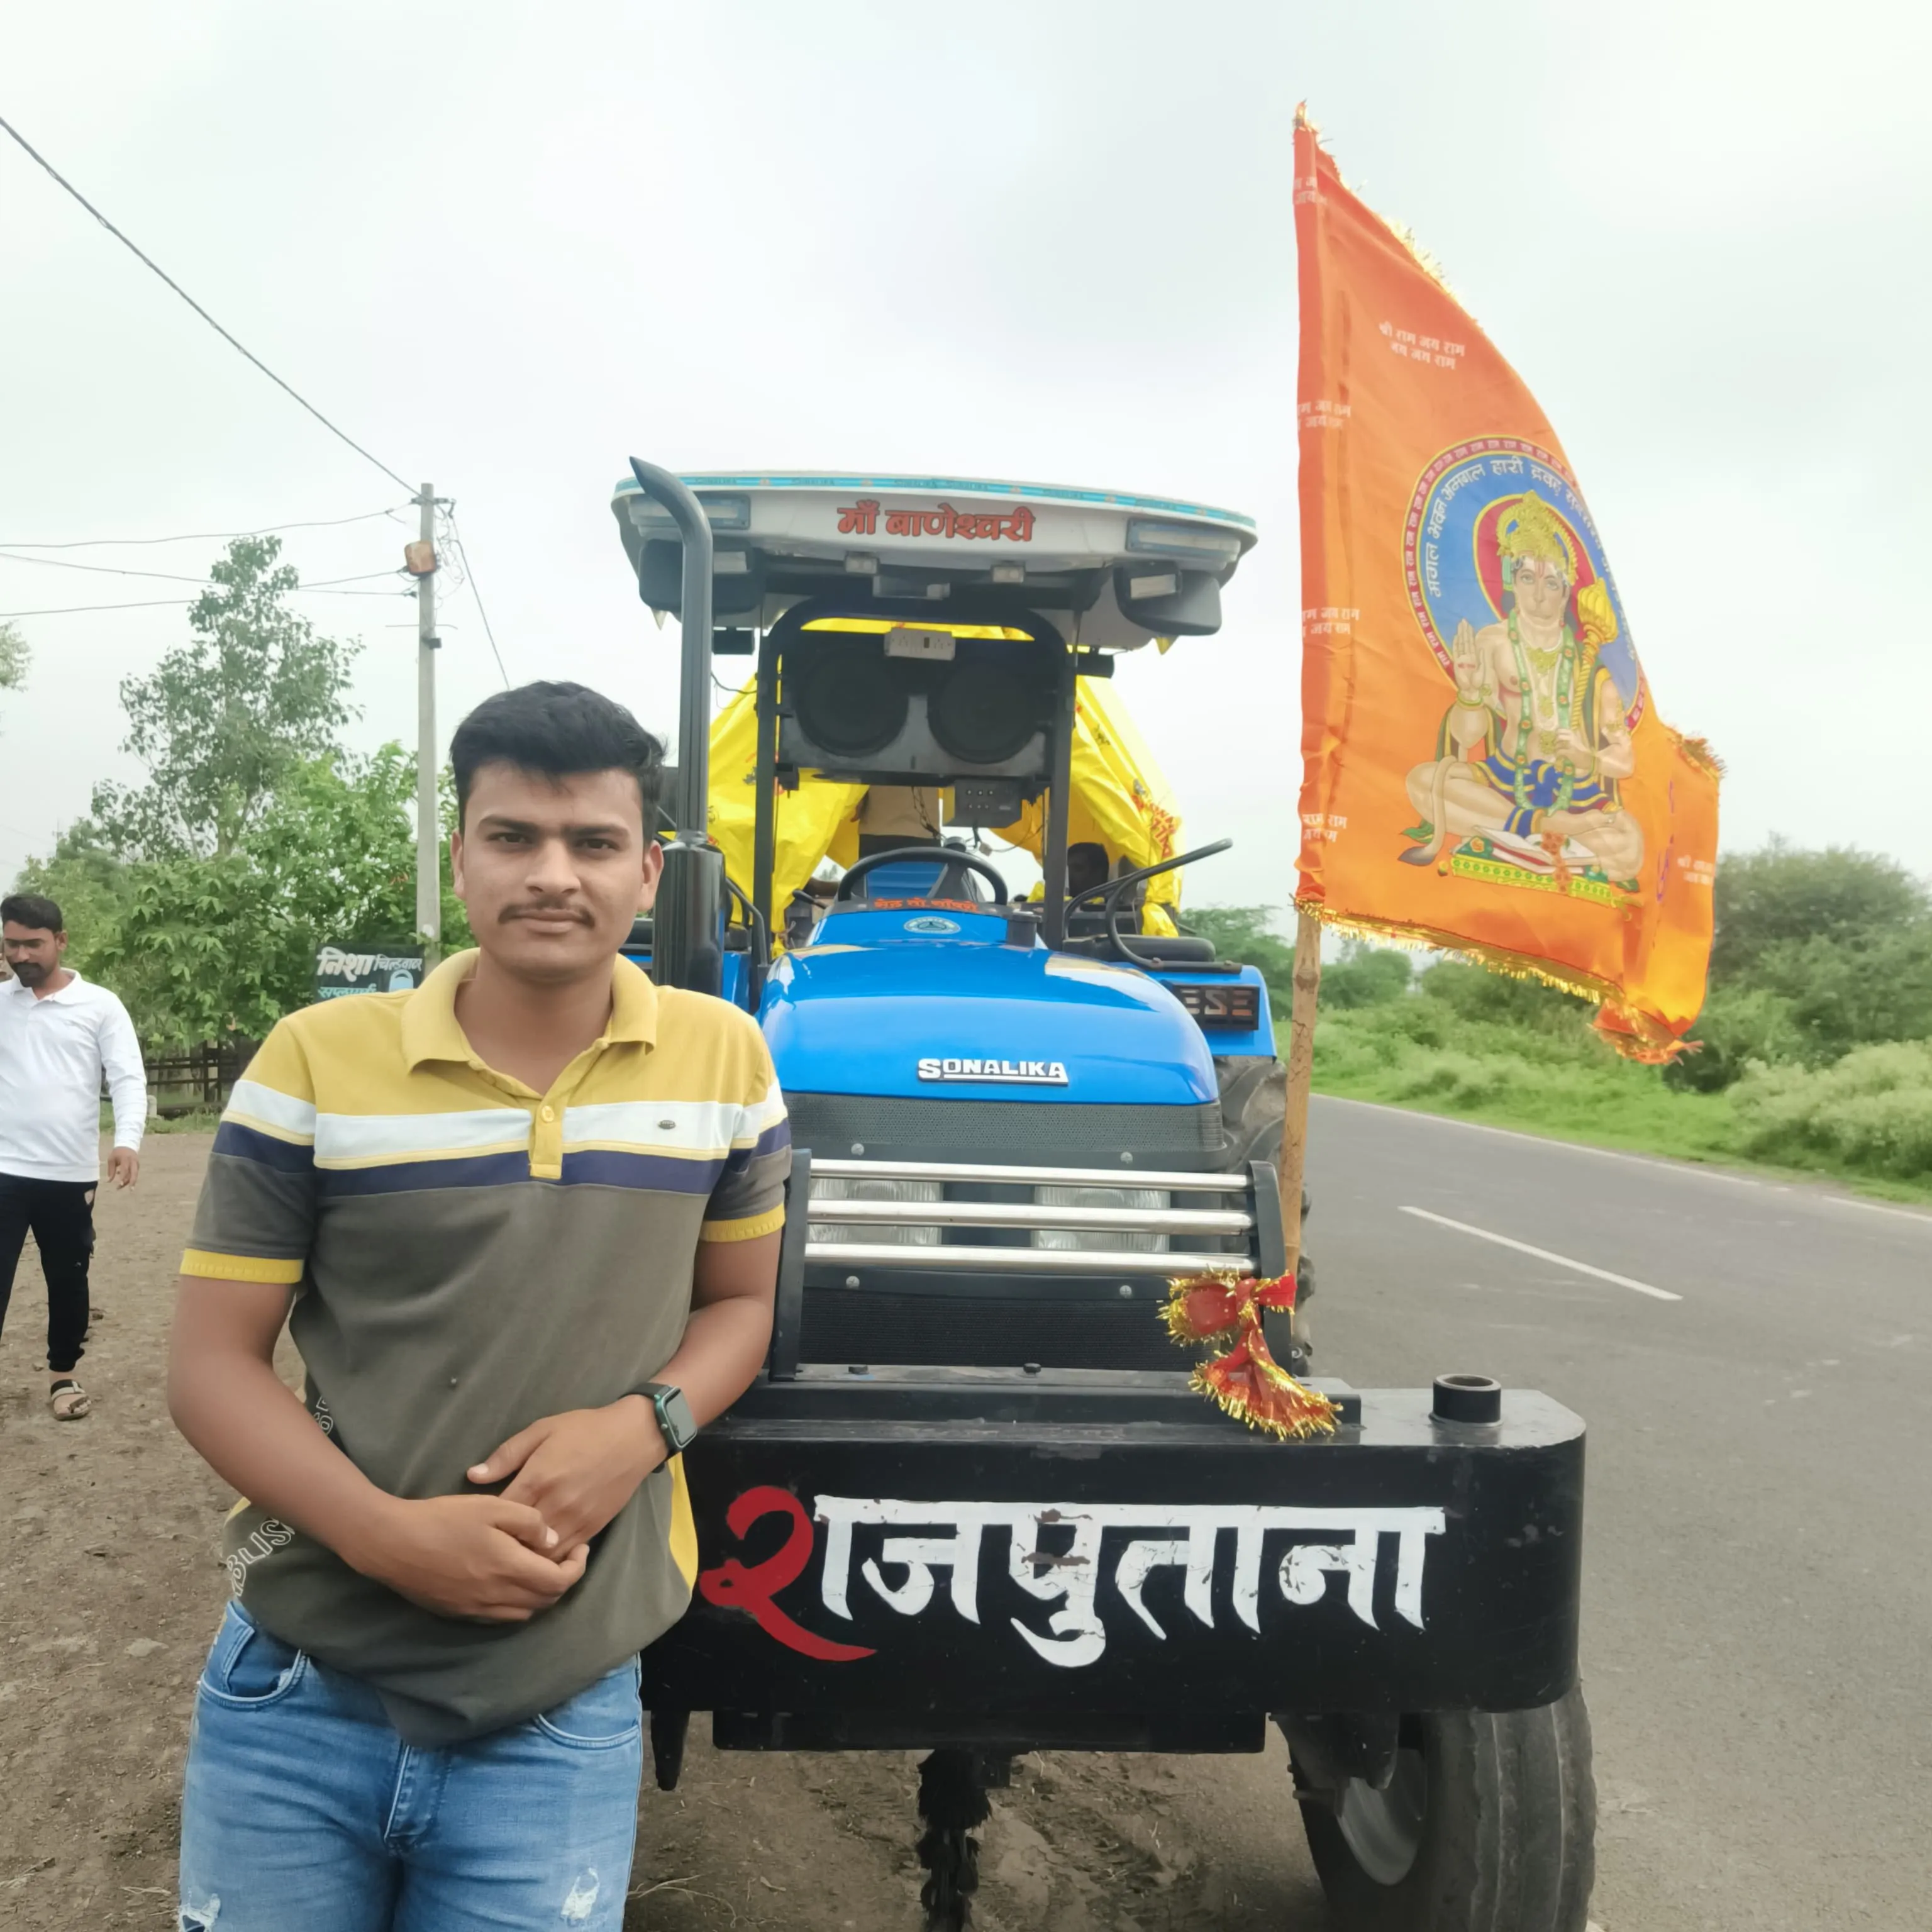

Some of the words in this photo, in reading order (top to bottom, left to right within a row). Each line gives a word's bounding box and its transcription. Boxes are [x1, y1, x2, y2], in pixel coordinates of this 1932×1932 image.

[1396, 329, 1416, 345] राम
[1443, 341, 1465, 357] राम
[1434, 354, 1456, 370] राम
[1490, 455, 1523, 475] हारी
[884, 502, 1036, 541] बाणेश्वरी
[316, 946, 377, 982] निशा
[918, 1058, 1069, 1084] SONALIKA
